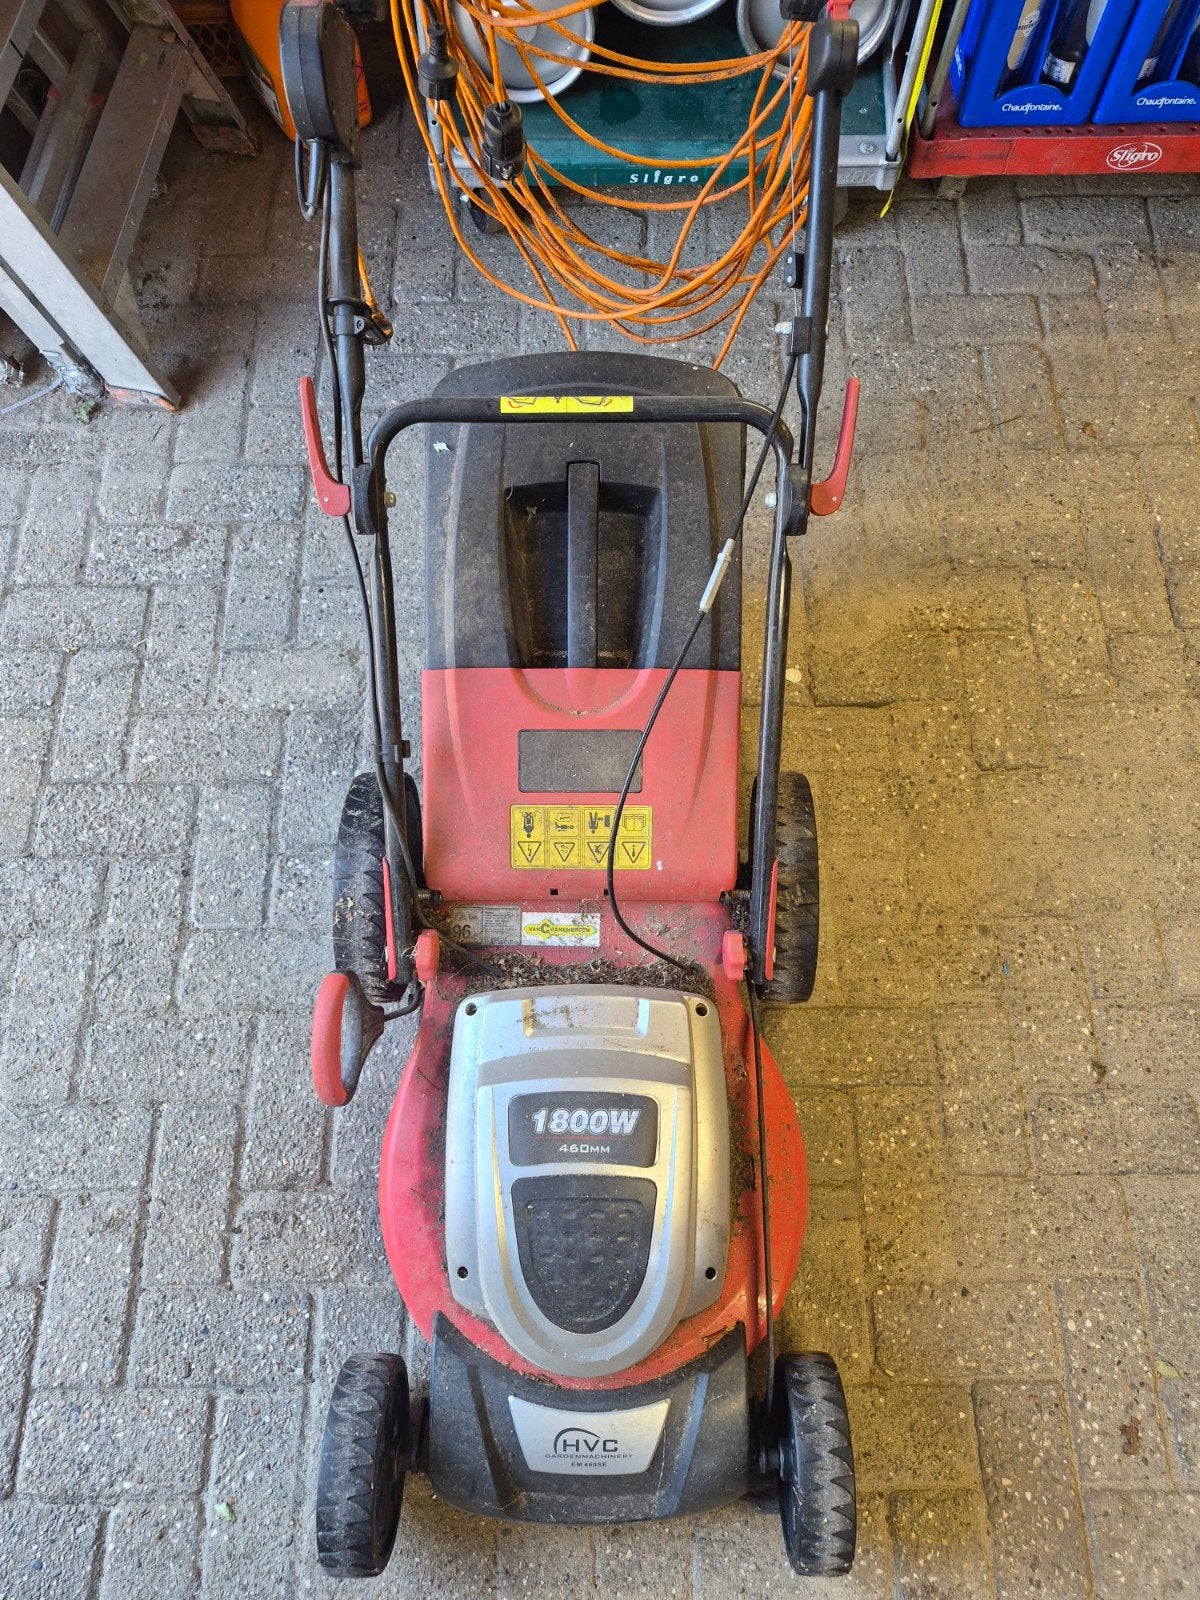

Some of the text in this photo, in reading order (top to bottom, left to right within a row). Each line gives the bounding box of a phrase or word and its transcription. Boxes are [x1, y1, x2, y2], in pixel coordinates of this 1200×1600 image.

[1109, 145, 1159, 167] Sligro
[629, 169, 699, 185] Sligro
[452, 924, 472, 940] 96
[532, 1107, 642, 1135] 1800W
[558, 1143, 610, 1154] 460MM
[562, 1438, 619, 1453] HVC
